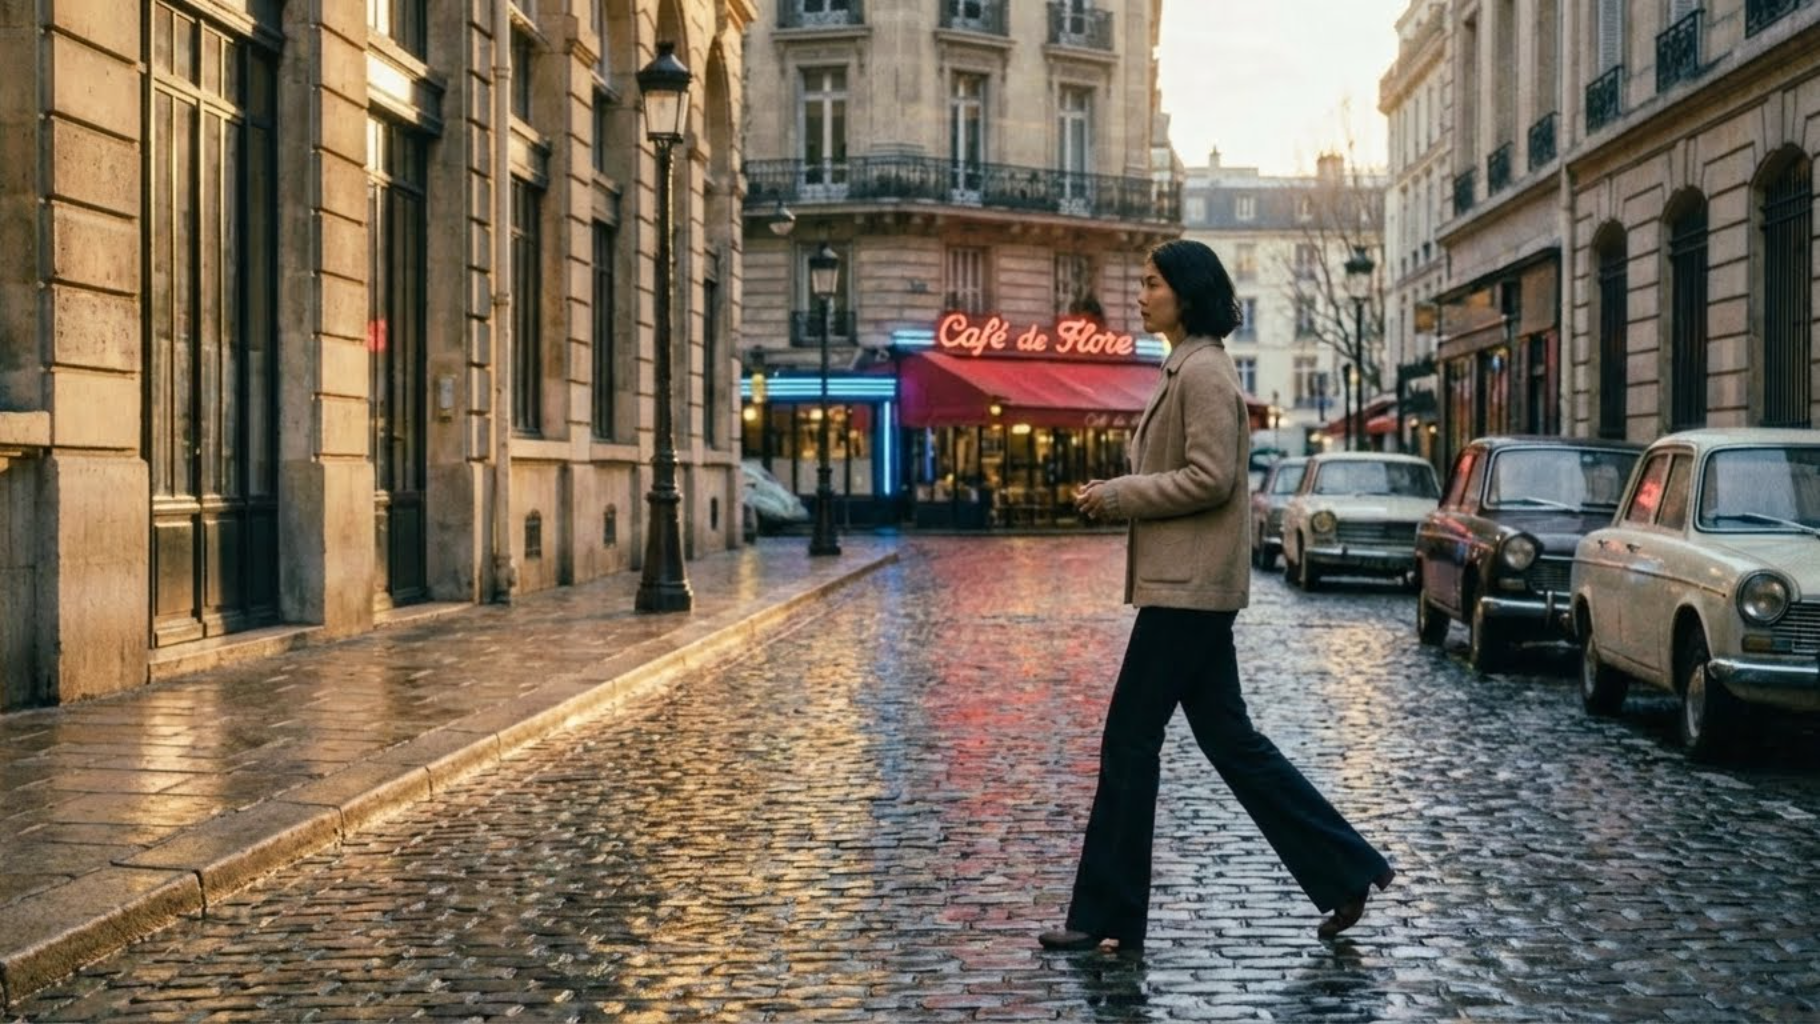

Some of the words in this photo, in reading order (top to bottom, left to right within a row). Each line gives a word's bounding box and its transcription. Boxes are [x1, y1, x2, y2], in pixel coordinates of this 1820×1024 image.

[939, 313, 1009, 356] Café
[1016, 324, 1048, 351] de
[1056, 318, 1133, 355] Flore
